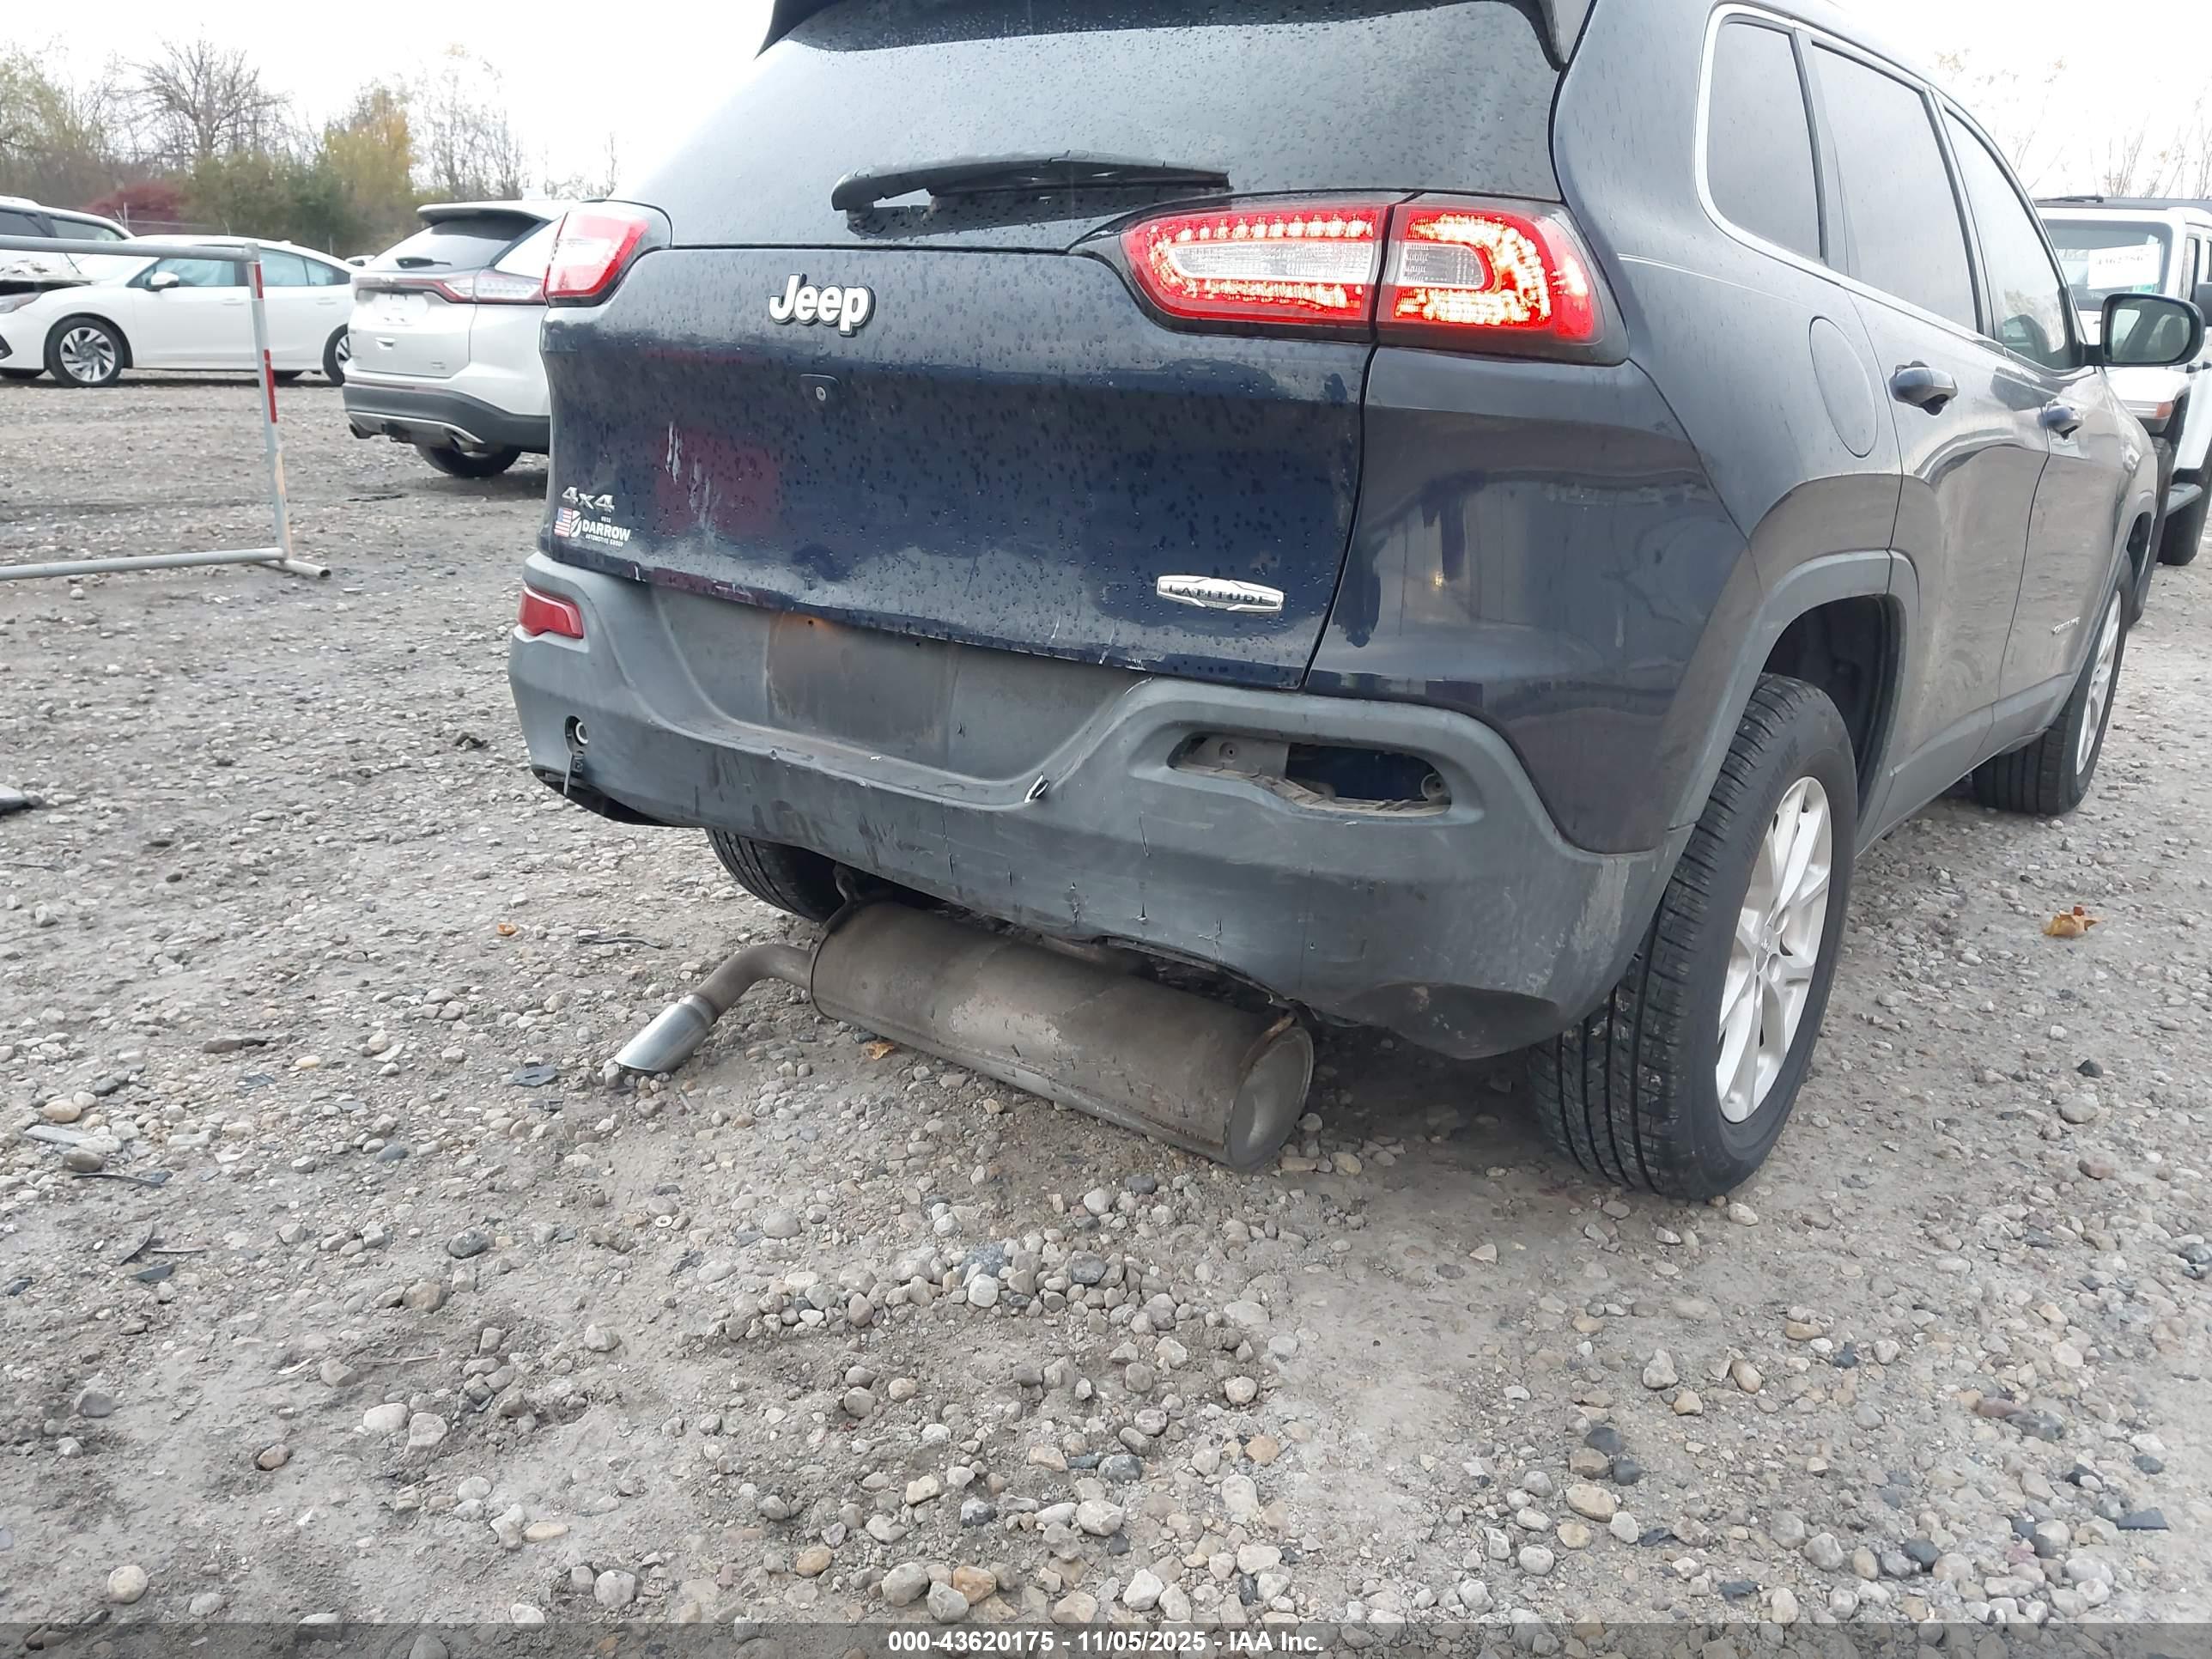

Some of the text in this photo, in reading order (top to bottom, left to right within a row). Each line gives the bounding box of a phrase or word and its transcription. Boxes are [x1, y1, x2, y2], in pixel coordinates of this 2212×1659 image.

[769, 273, 873, 336] Jeep
[562, 486, 615, 512] 4x4
[581, 519, 631, 542] DARROW
